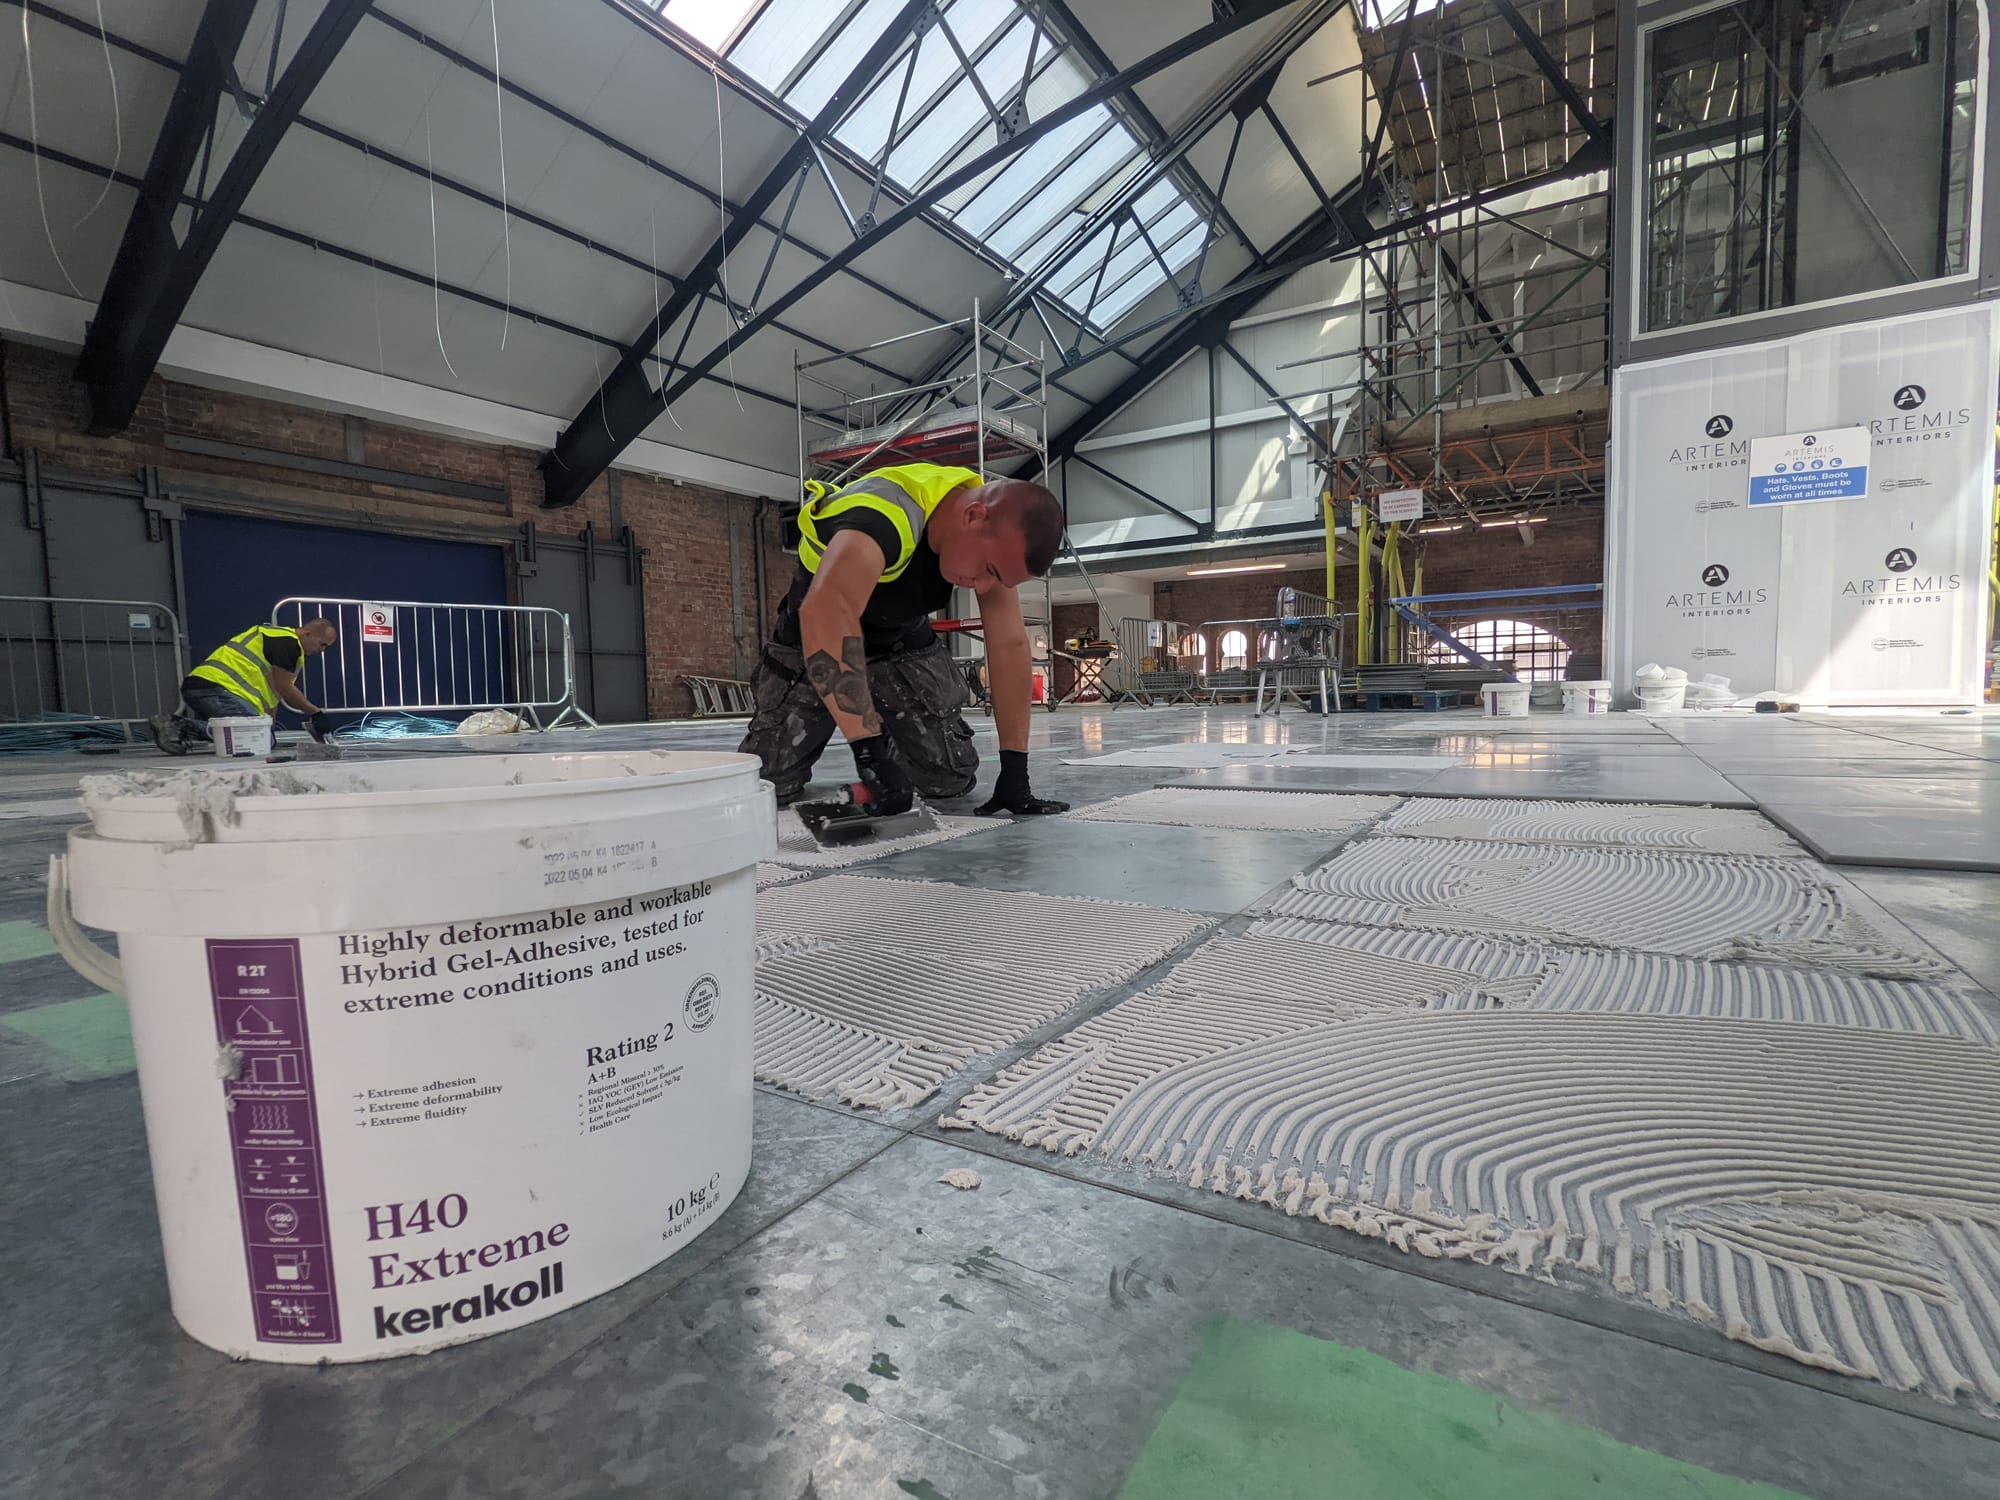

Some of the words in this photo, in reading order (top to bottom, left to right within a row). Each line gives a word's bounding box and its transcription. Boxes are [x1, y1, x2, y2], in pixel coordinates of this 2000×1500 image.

[1857, 409, 1970, 433] RTEMIS
[1669, 440, 1746, 462] ARTEM
[1785, 445, 1835, 457] ARTEMIS
[1686, 459, 1746, 471] INTERIOR
[1821, 471, 1849, 480] Boots
[1763, 485, 1780, 493] and
[1782, 482, 1813, 492] Gloves
[1815, 480, 1838, 488] must
[1840, 478, 1852, 487] be
[1770, 492, 1792, 500] worn
[1818, 488, 1843, 496] times
[1842, 574, 1961, 595] ARTEMIS
[1666, 588, 1767, 608] ARTEMIS
[1862, 595, 1942, 606] INTERIORS
[1682, 608, 1751, 618] INTERIORS
[568, 868, 580, 881] 05
[582, 867, 593, 879] 04
[338, 930, 432, 958] Highly
[438, 908, 587, 946] deformable
[593, 899, 634, 924] and
[639, 879, 712, 913] workable
[340, 958, 437, 989] Hybrid
[446, 935, 617, 975] Gel-Adhesive,
[623, 913, 679, 942] tested
[682, 908, 705, 929] for
[344, 989, 455, 1015] extreme
[463, 964, 594, 1001] conditions
[601, 951, 640, 976] and
[645, 940, 687, 962] uses.
[586, 1033, 659, 1067] Rating
[663, 1022, 674, 1042] 2
[587, 1066, 617, 1085] A+B
[588, 1080, 619, 1096] Regional
[620, 1071, 646, 1085] Mineral
[367, 1085, 419, 1099] Extreme
[422, 1076, 477, 1092] adhesion
[369, 1099, 420, 1113] Extreme
[423, 1085, 504, 1106] deformability
[588, 1095, 604, 1105] IAQ
[605, 1088, 622, 1099] VOC
[645, 1076, 658, 1085] Low
[605, 1094, 635, 1108] Reduced
[636, 1084, 659, 1098] Solvent
[370, 1113, 421, 1127] Extreme
[424, 1105, 468, 1120] fluidity
[589, 1114, 604, 1124] Low
[606, 1100, 640, 1117] Ecological
[642, 1091, 663, 1104] Impact
[589, 1119, 613, 1133] Health
[614, 1113, 631, 1124] Care
[667, 1198, 685, 1222] 10
[690, 1185, 707, 1209] kg
[363, 1193, 468, 1242] H40
[368, 1222, 570, 1290] Extreme
[373, 1261, 564, 1340] kerakoll
